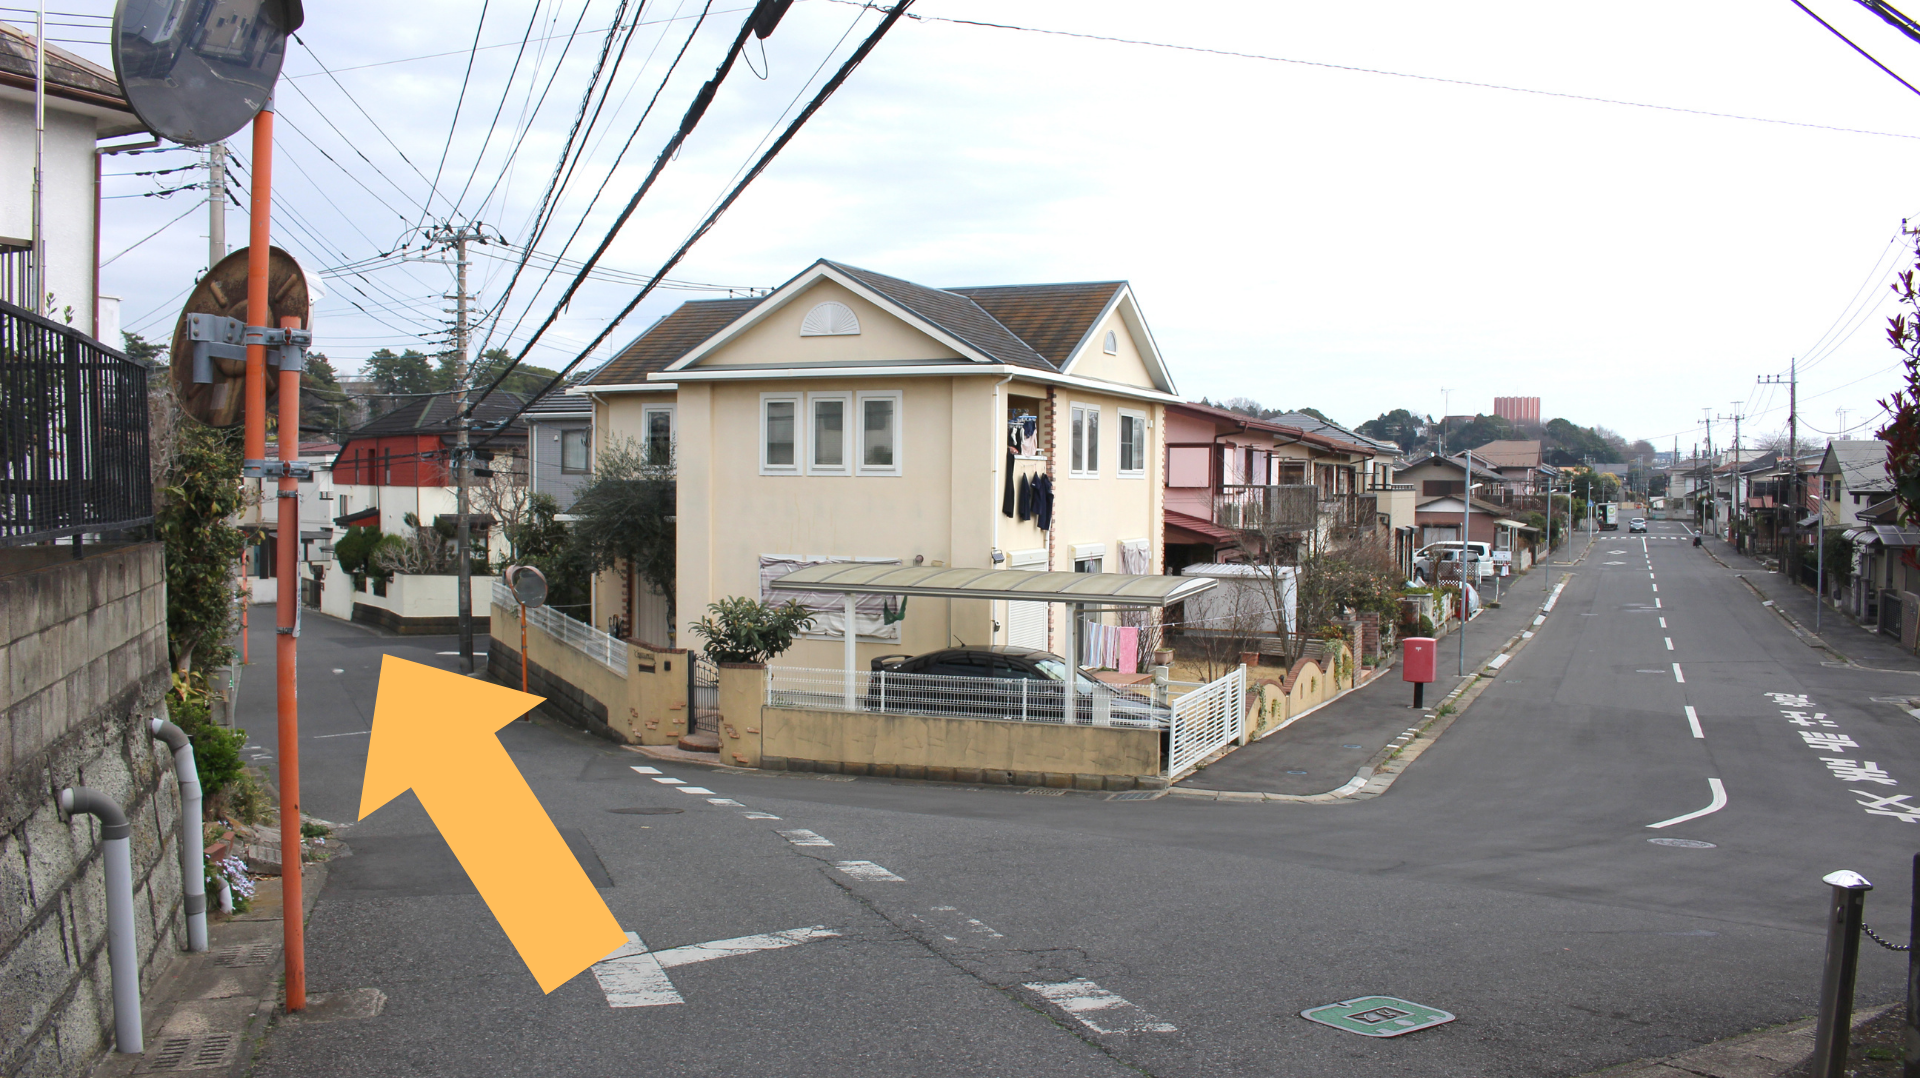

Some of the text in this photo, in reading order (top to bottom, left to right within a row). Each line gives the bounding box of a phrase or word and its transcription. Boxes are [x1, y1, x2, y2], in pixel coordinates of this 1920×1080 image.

[1764, 692, 1920, 823] 交差点注意
